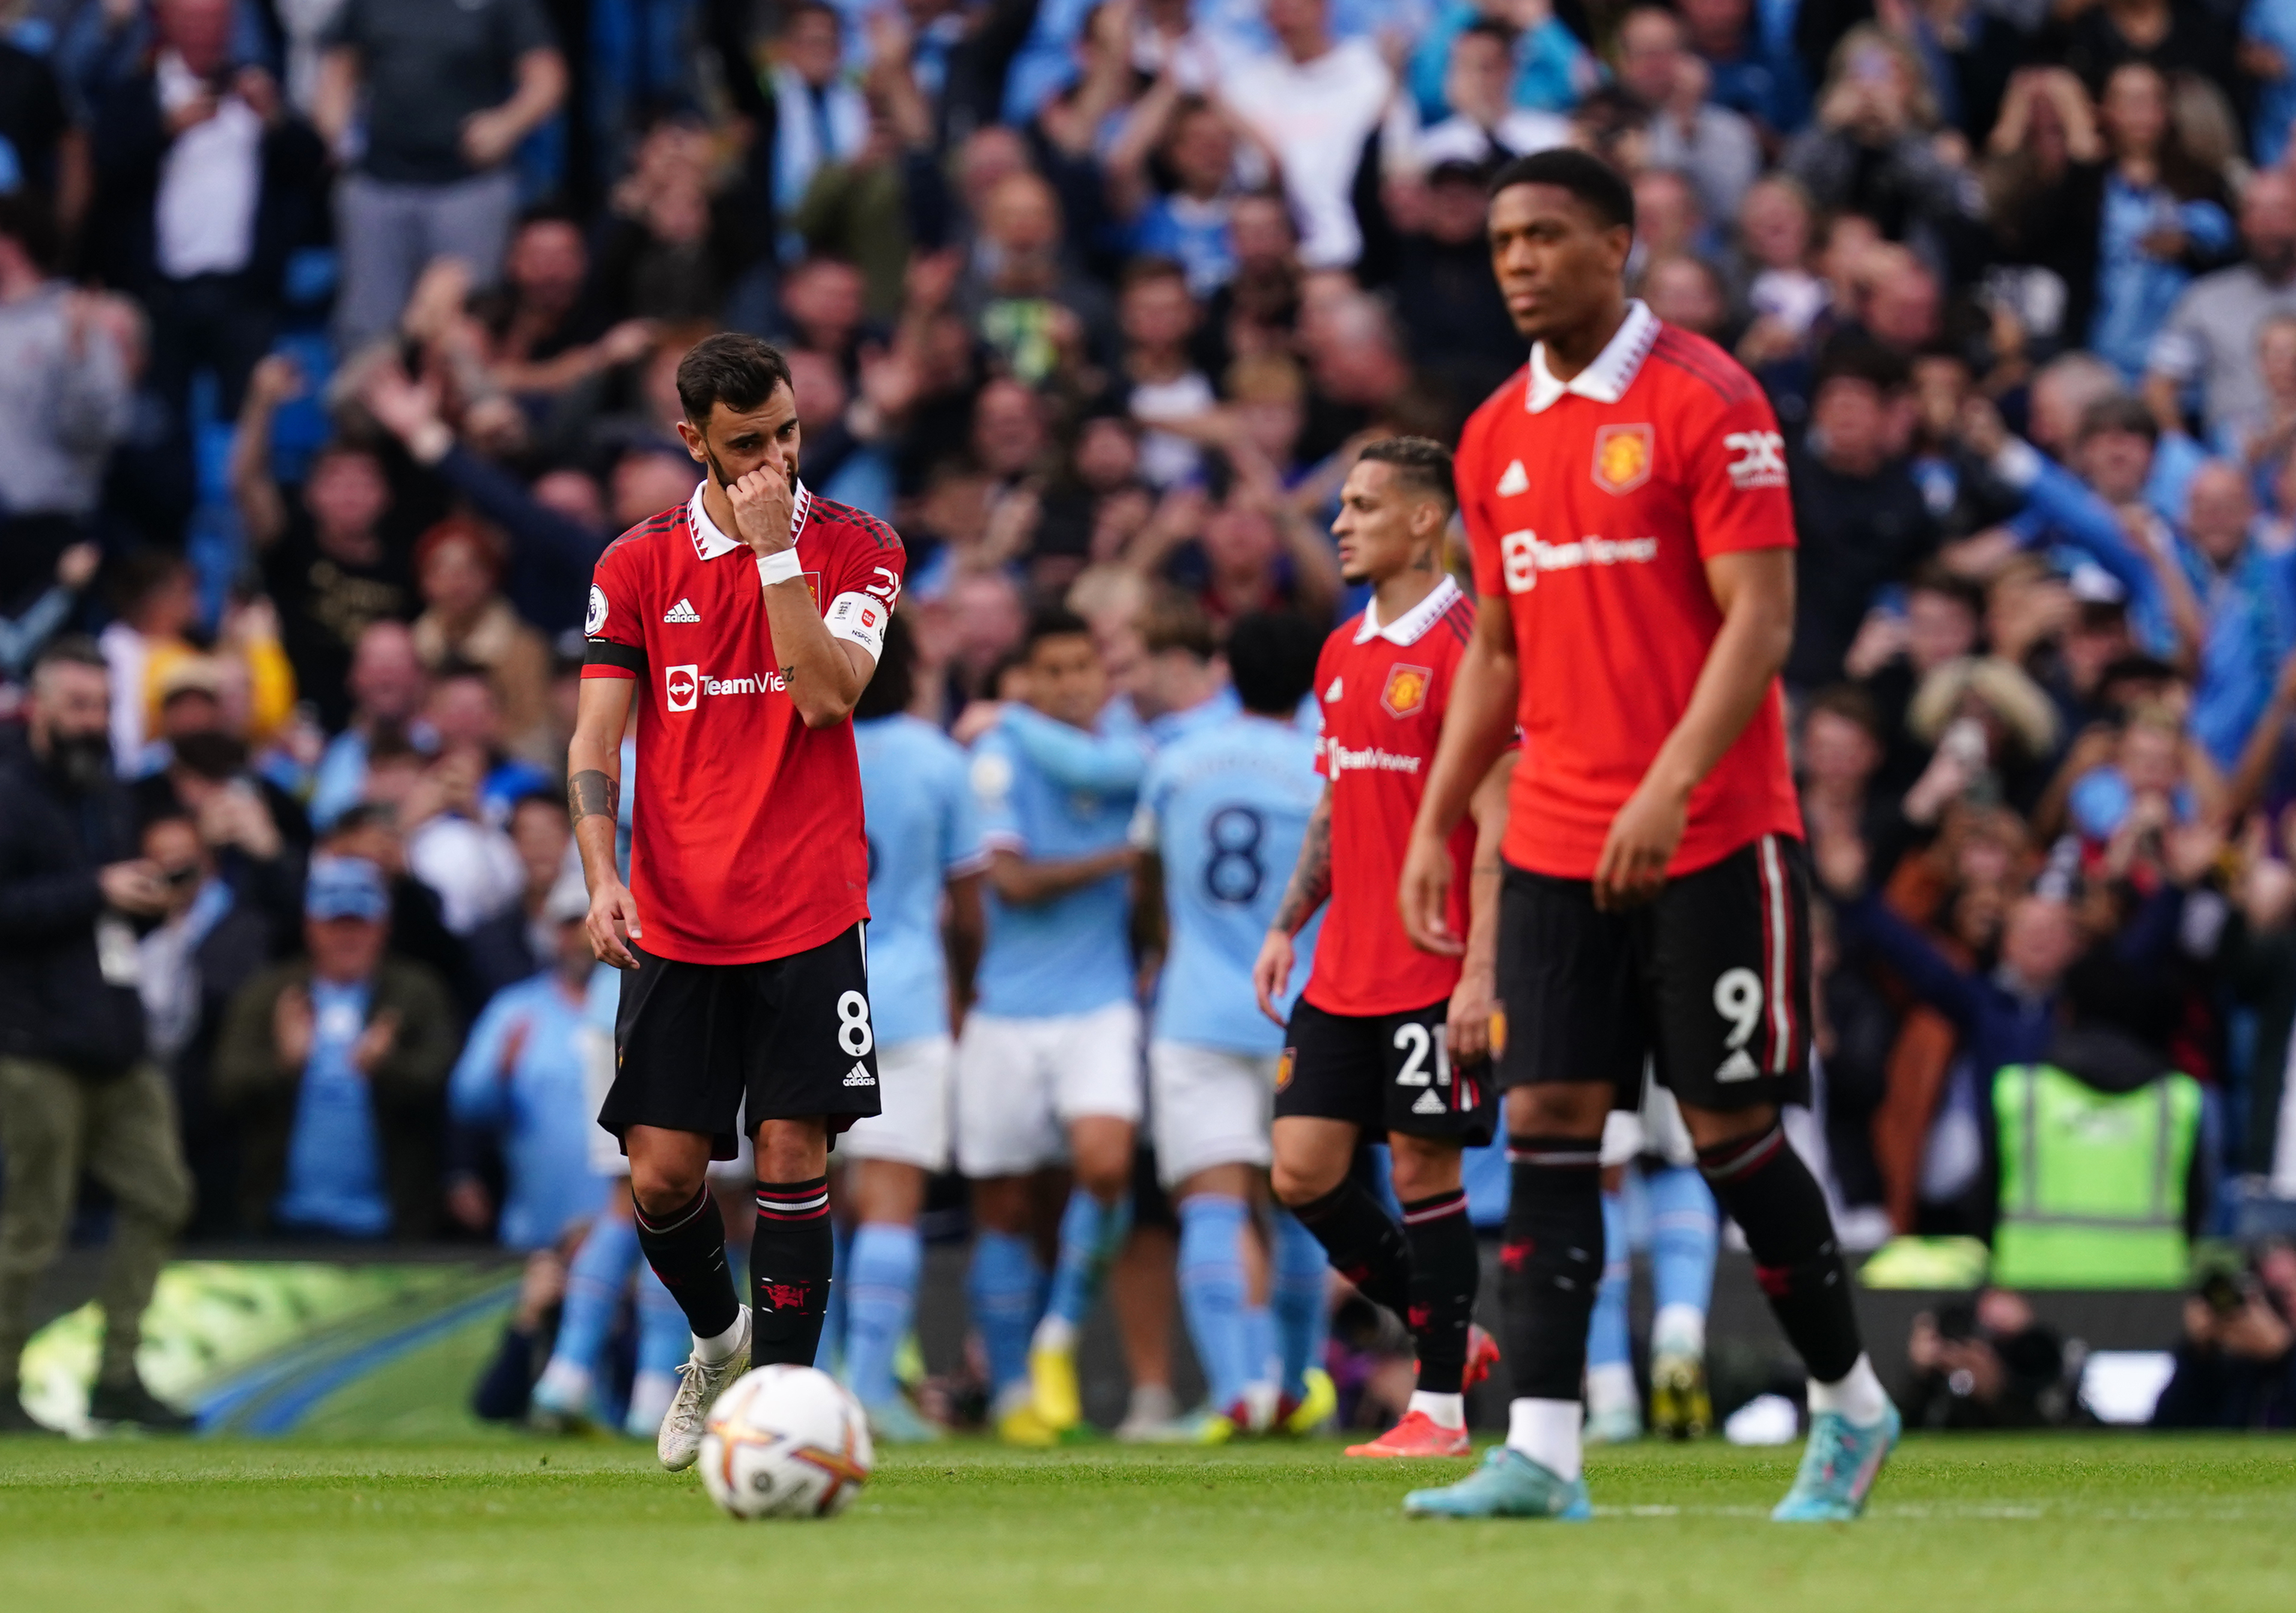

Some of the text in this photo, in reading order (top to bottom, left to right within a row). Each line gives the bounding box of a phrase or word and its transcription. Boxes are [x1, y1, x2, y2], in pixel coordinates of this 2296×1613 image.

[664, 614, 701, 623] adidas
[852, 630, 872, 645] NSPCC
[699, 672, 785, 695] TeamVie
[1205, 805, 1262, 901] 8
[837, 990, 872, 1057] 8
[1713, 966, 1764, 1049] 9
[1393, 1022, 1451, 1086] 21
[843, 1077, 875, 1087] adidas
